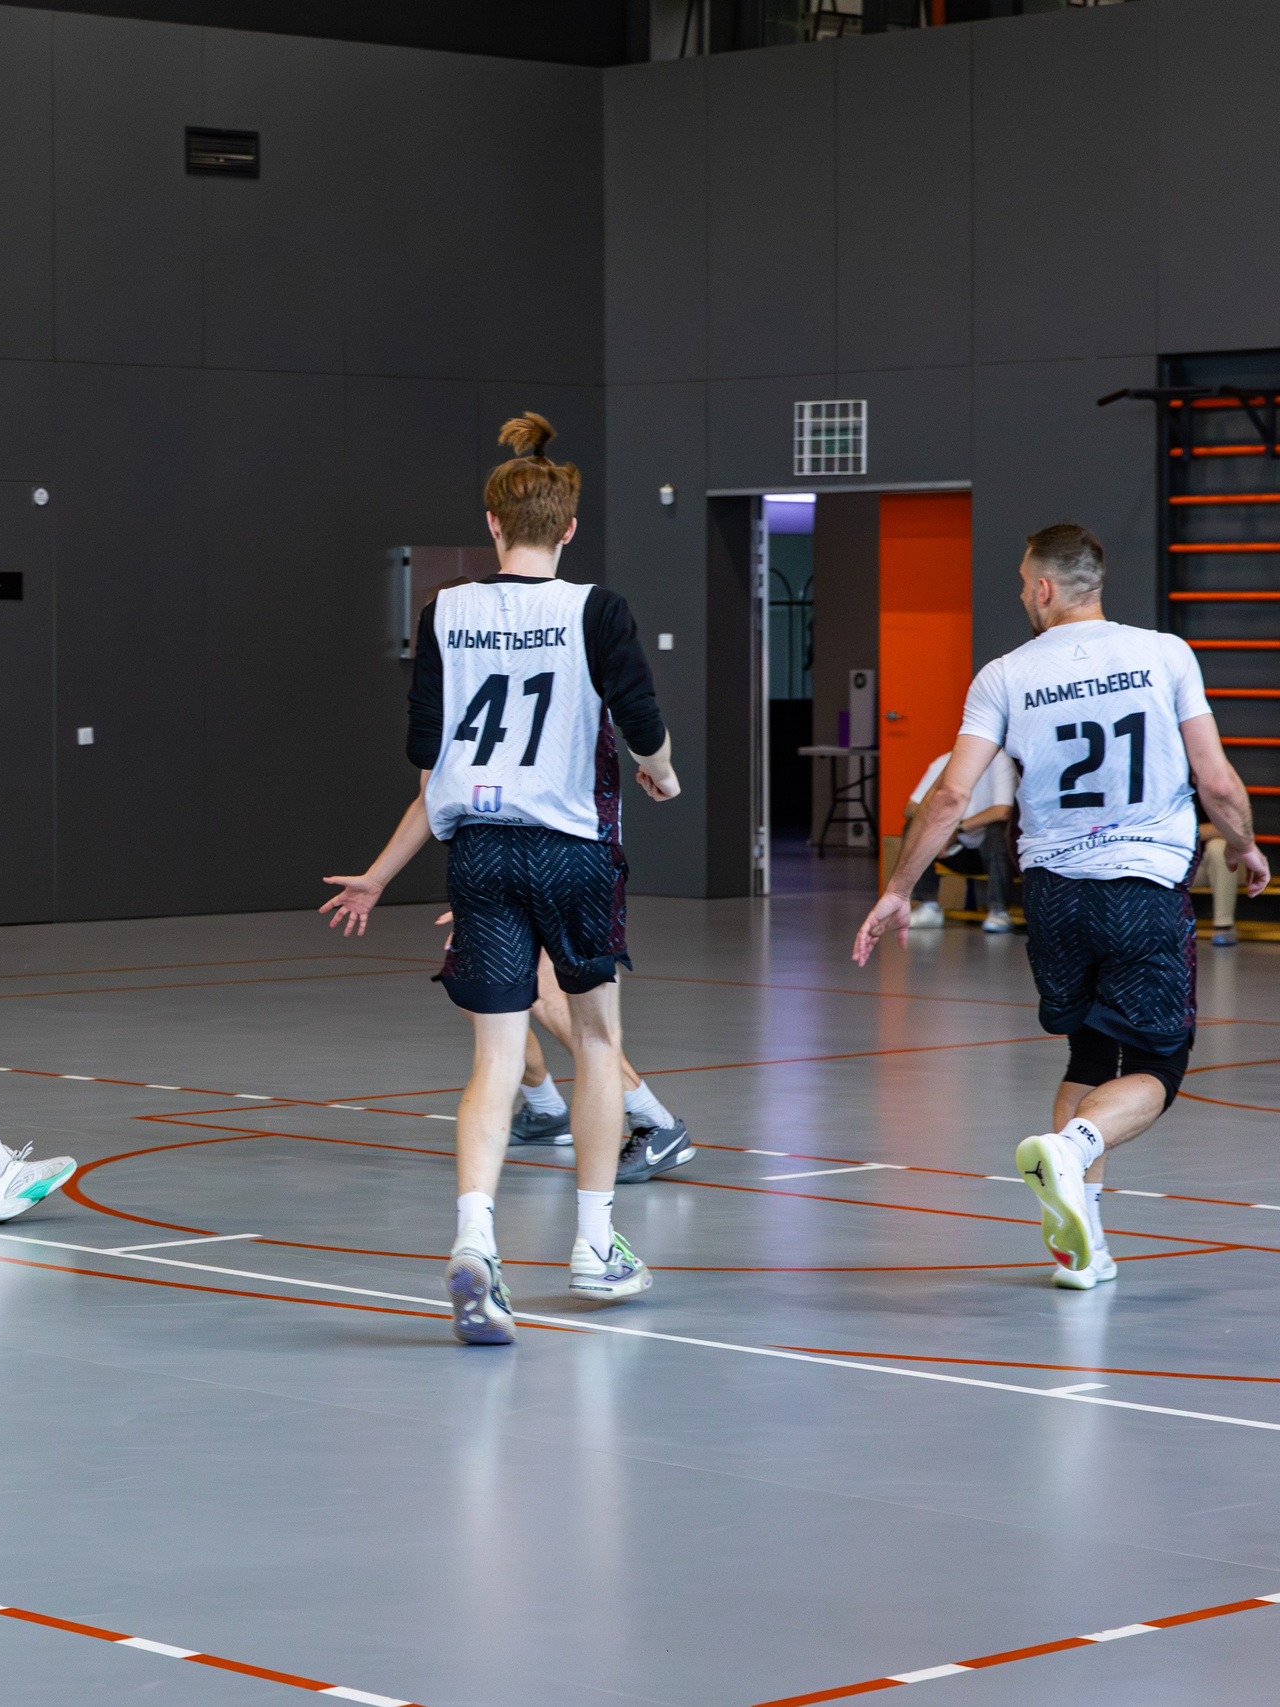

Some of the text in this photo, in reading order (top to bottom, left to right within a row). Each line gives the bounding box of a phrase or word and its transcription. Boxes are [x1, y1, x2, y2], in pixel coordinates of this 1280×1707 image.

[447, 626, 566, 651] АЛЬМЕТЬЕВСК
[453, 671, 555, 767] 41
[1024, 669, 1154, 711] АЛЬМЕТЬЕВСК
[1056, 711, 1146, 809] 21
